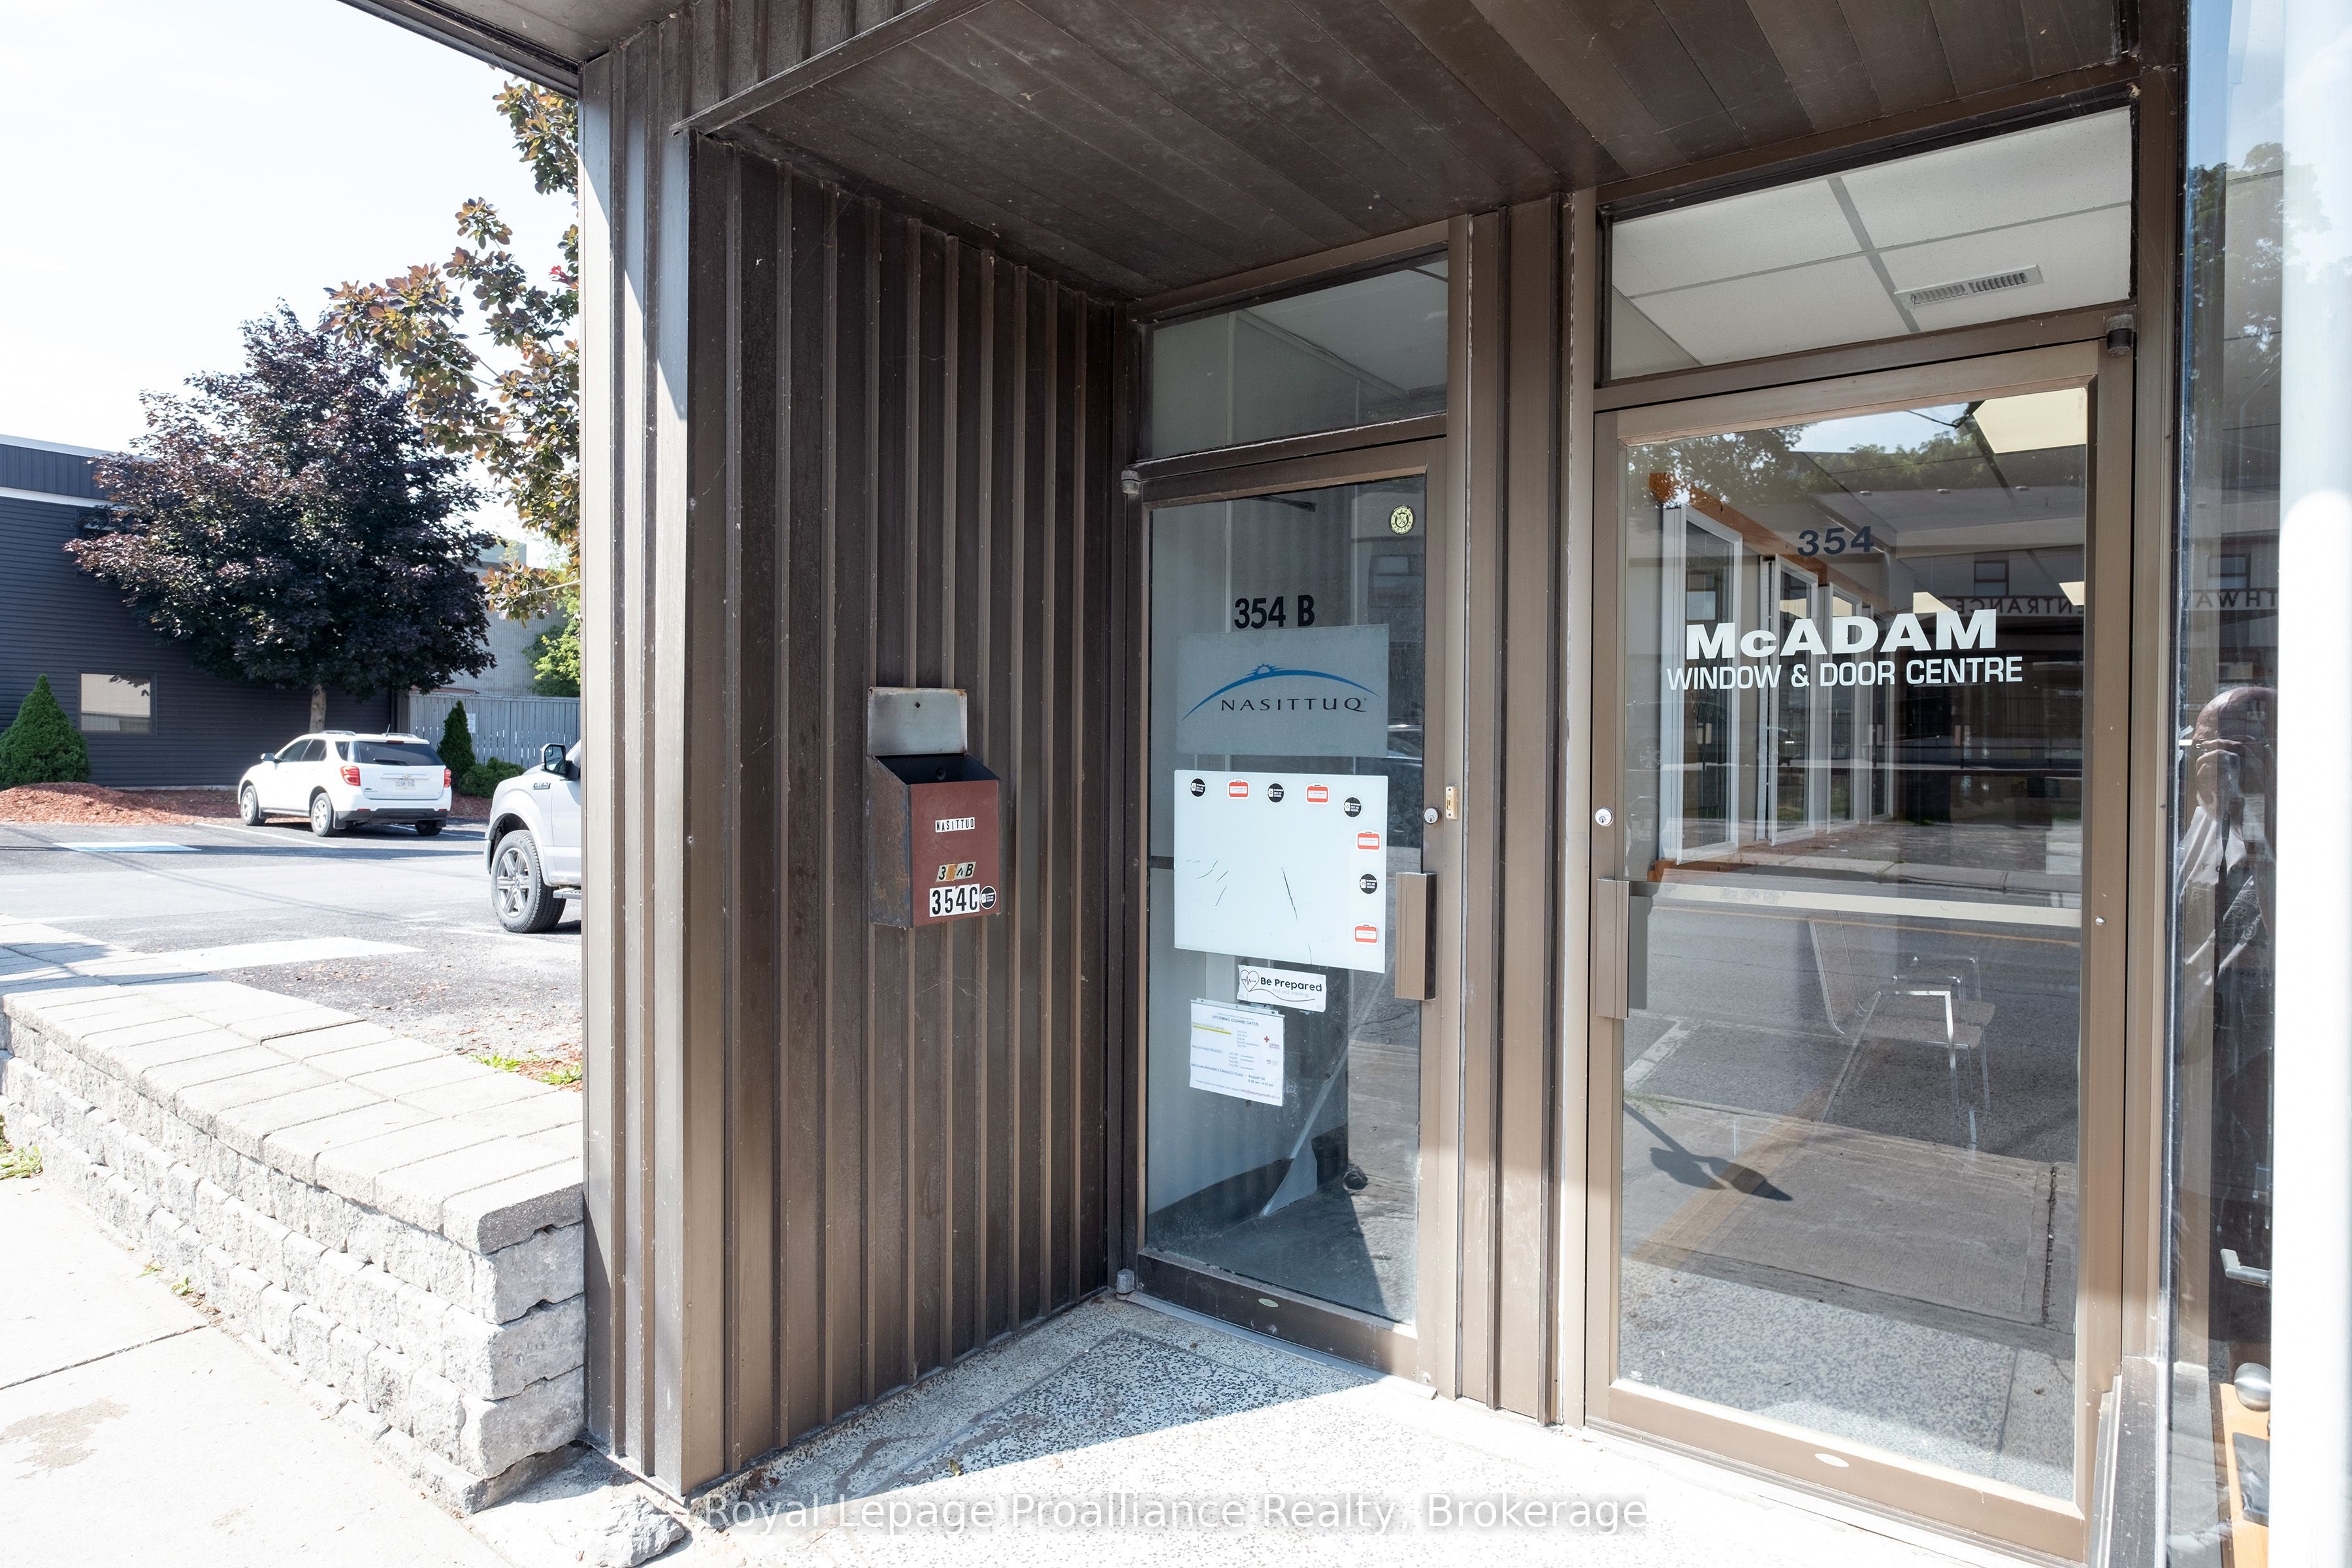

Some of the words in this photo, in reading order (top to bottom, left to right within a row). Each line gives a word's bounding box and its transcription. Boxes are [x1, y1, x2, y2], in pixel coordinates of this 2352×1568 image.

[1797, 526, 1874, 556] 354
[1234, 596, 1286, 629] 354
[1298, 595, 1315, 627] B
[1687, 609, 1996, 659] McADAM
[1667, 664, 1782, 690] WINDOW
[1791, 664, 1810, 687] &
[1820, 661, 1895, 687] DOOR
[1906, 656, 2023, 684] CENTRE
[1221, 697, 1367, 712] NASITTUQ
[938, 863, 974, 880] 34B
[932, 887, 978, 915] 354C
[1260, 977, 1272, 986] Be
[1275, 979, 1322, 992] Prepared
